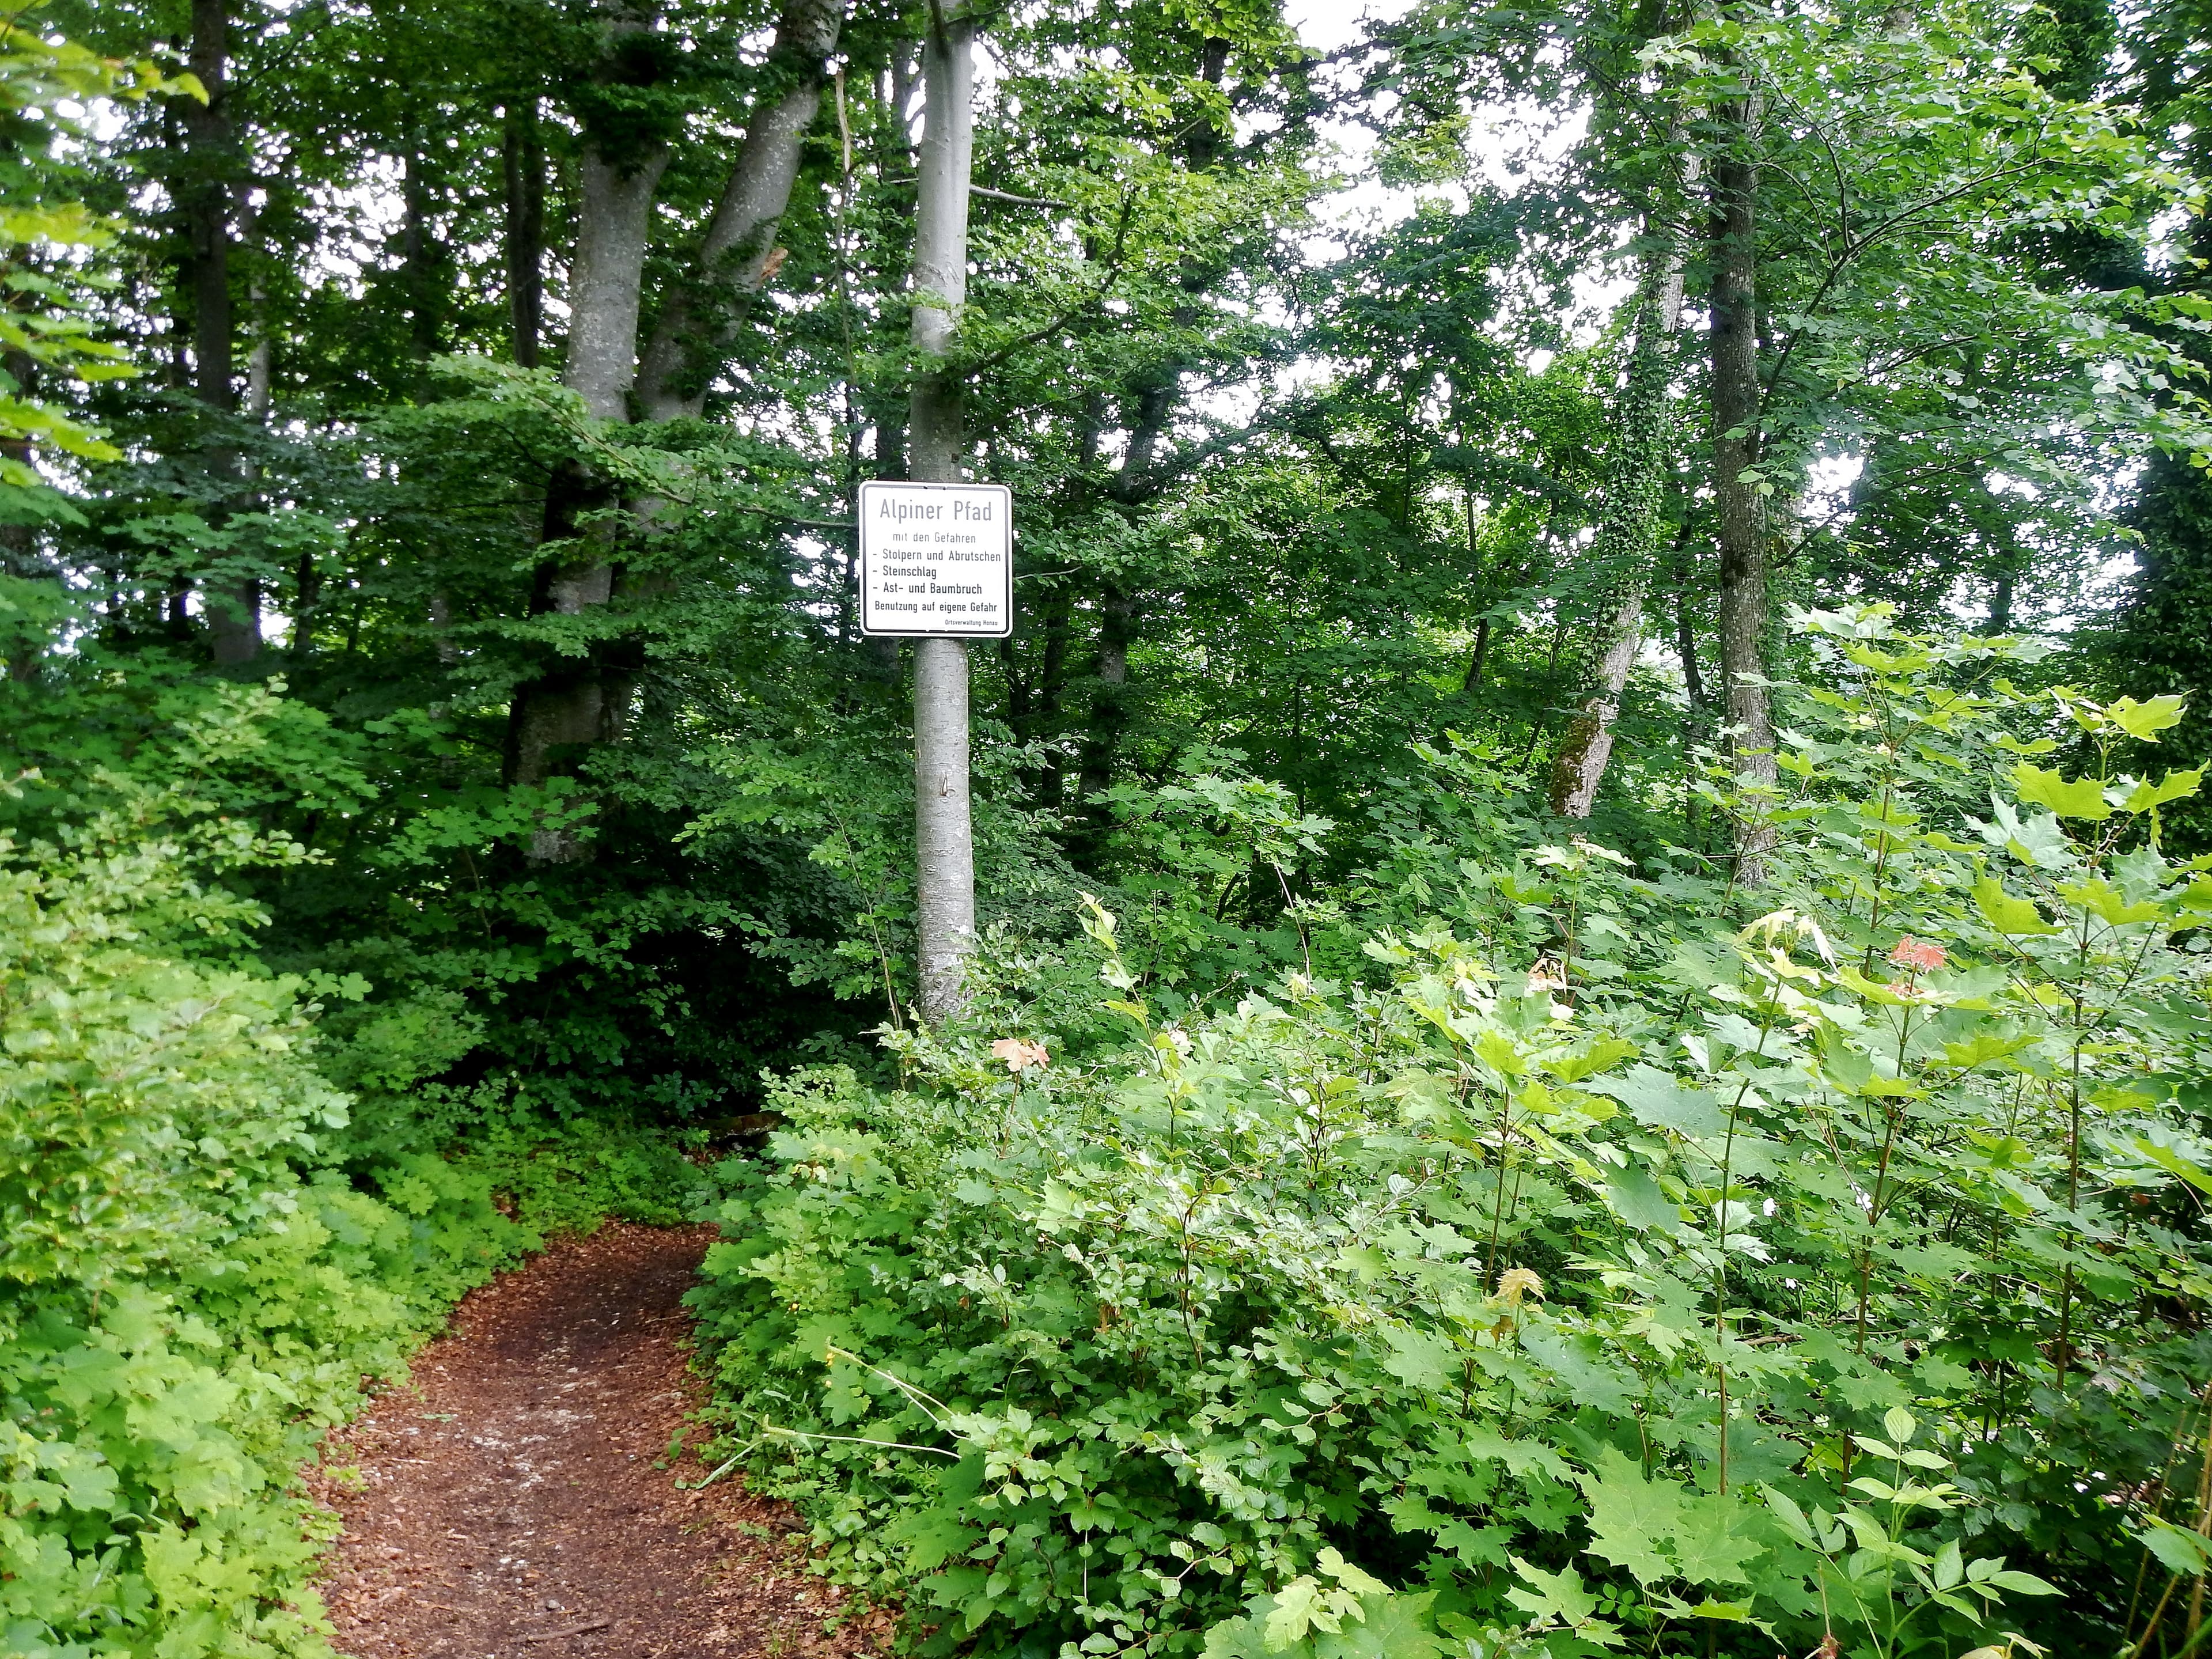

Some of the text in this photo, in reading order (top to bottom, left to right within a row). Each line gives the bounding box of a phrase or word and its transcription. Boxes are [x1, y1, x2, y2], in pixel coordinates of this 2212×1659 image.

[880, 499, 991, 524] Alpiner Pfad
[893, 532, 975, 543] mit den Gefahren
[883, 548, 922, 562] Stolpern
[927, 550, 943, 560] und
[949, 551, 1001, 561] Abrutschen
[883, 565, 936, 579] Steinschlag
[884, 582, 903, 593] Ast-
[909, 582, 925, 593] und
[930, 583, 982, 594] Baumbruch
[875, 601, 997, 613] Benutzung auf eigene Gefahr
